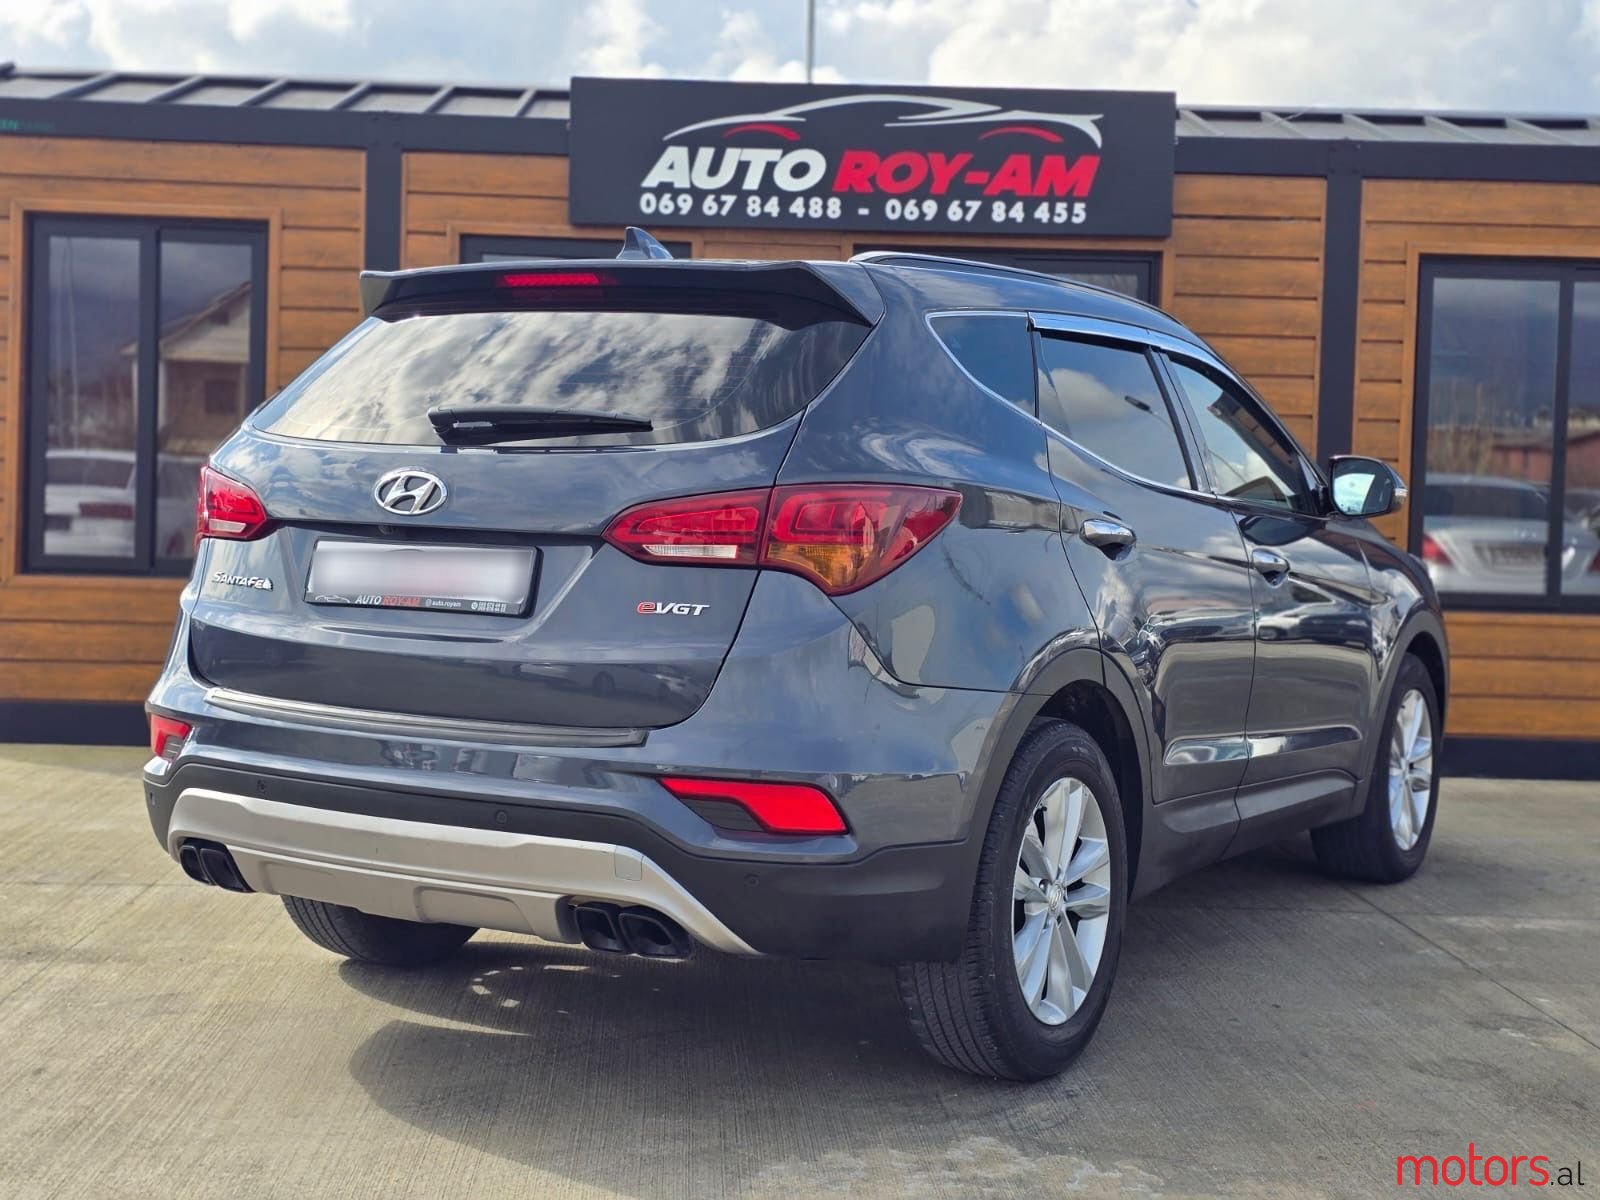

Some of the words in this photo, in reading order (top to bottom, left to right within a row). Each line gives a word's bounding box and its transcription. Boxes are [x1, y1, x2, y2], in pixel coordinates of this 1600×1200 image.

[640, 145, 827, 193] AUTO
[832, 149, 1101, 198] ROY-AM
[639, 192, 694, 216] 069
[702, 194, 738, 217] 67
[746, 195, 781, 218] 84
[788, 196, 842, 220] 488
[884, 198, 939, 222] 069
[946, 199, 983, 223] 67
[991, 200, 1025, 223] 84
[1033, 201, 1087, 224] 455
[354, 594, 383, 606] AUTO
